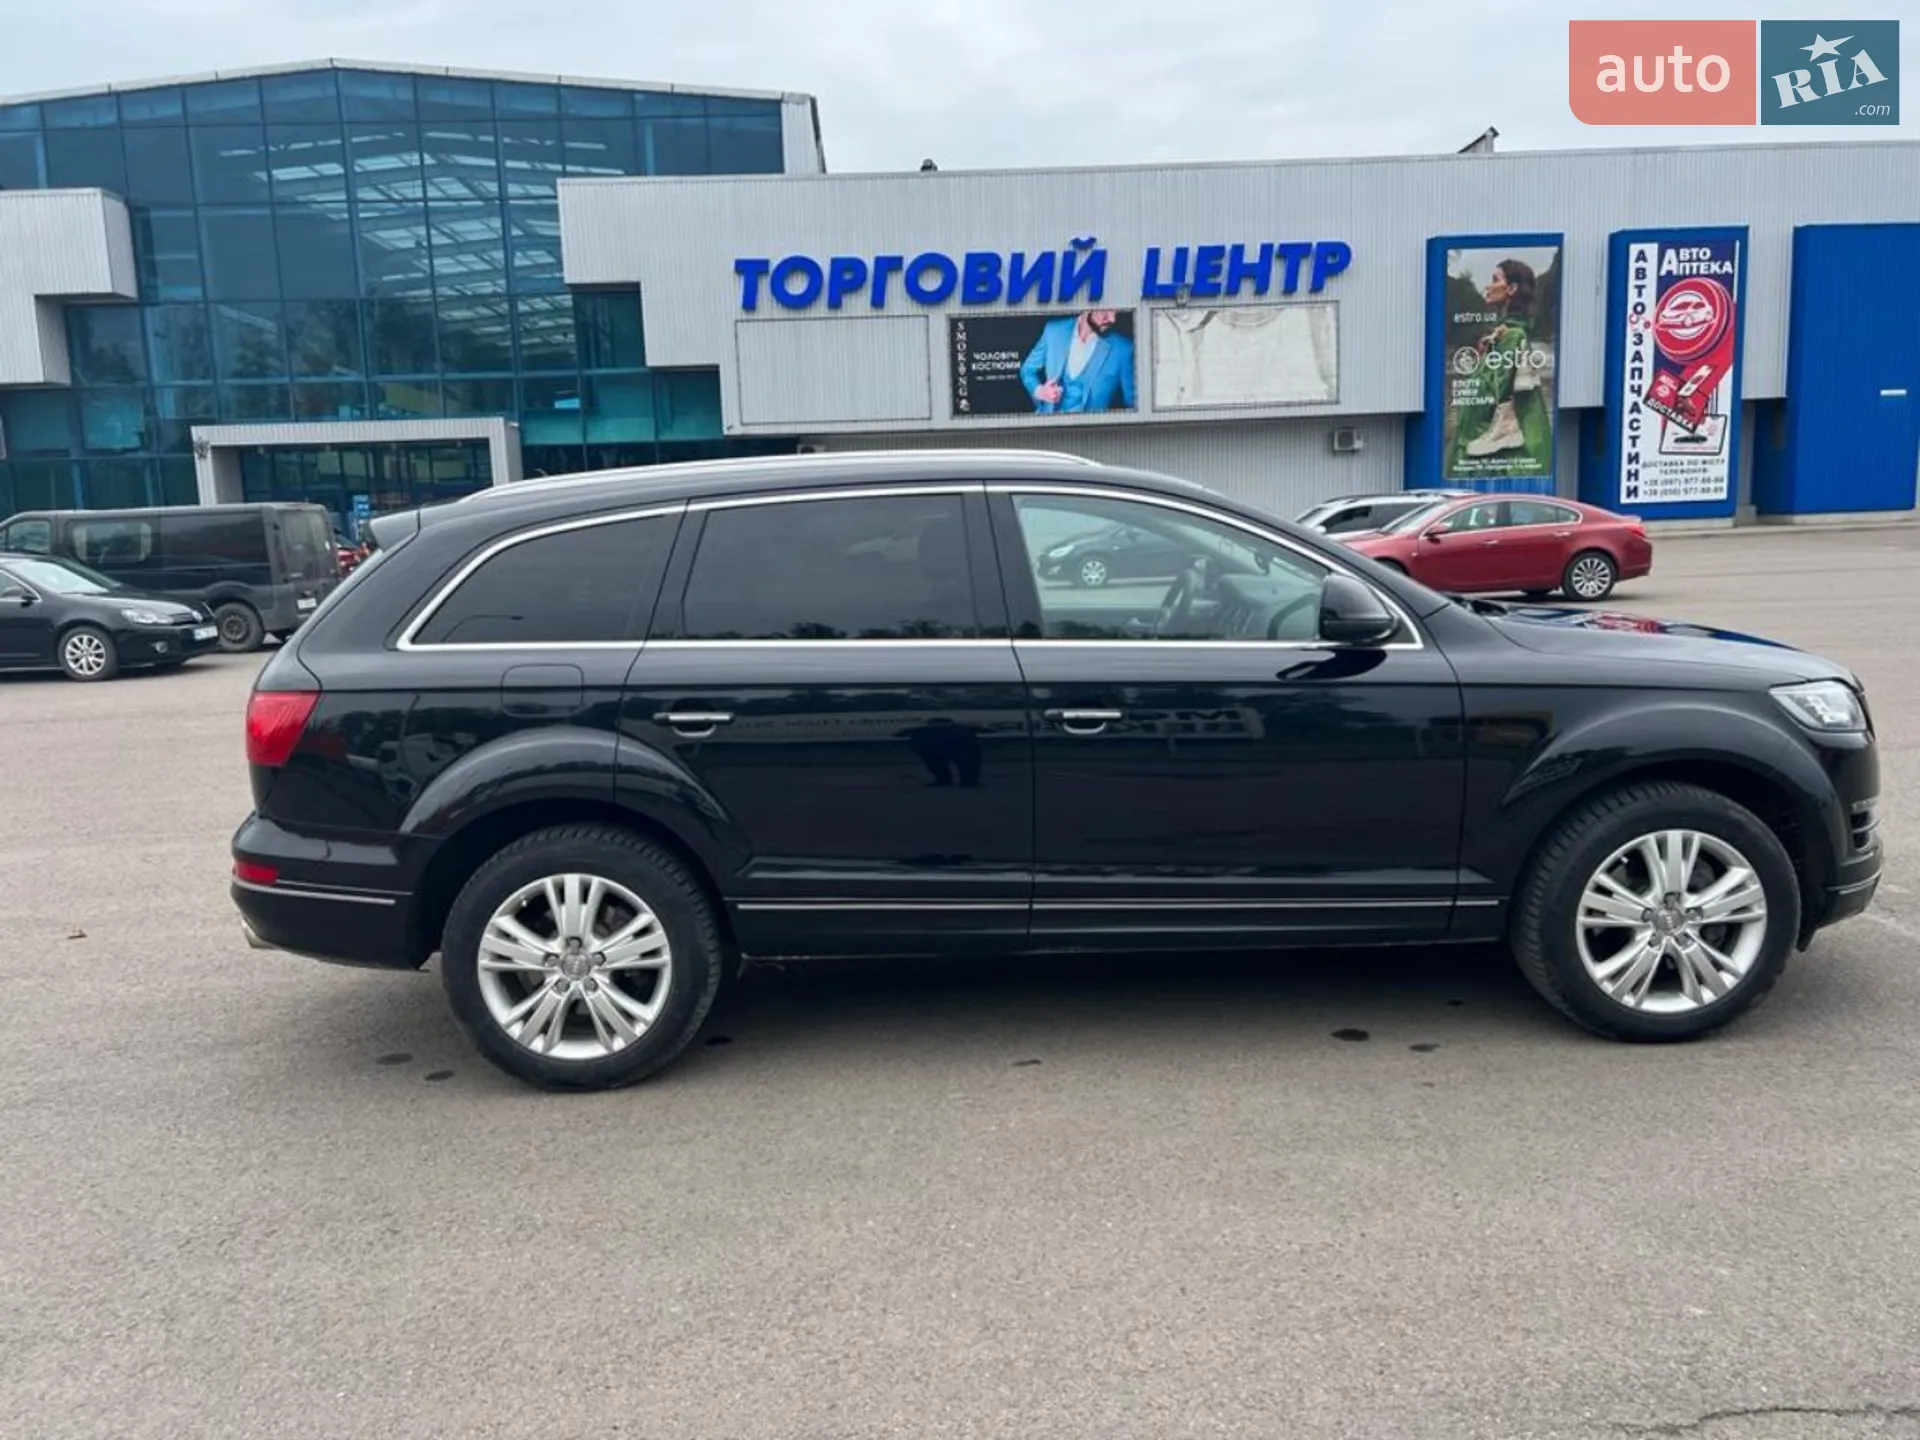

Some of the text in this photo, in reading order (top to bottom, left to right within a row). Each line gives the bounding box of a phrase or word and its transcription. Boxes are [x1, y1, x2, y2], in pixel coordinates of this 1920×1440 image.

[734, 237, 1352, 311] ТОРГОВИЙ ЦЕНТР
[1485, 347, 1546, 370] estro
